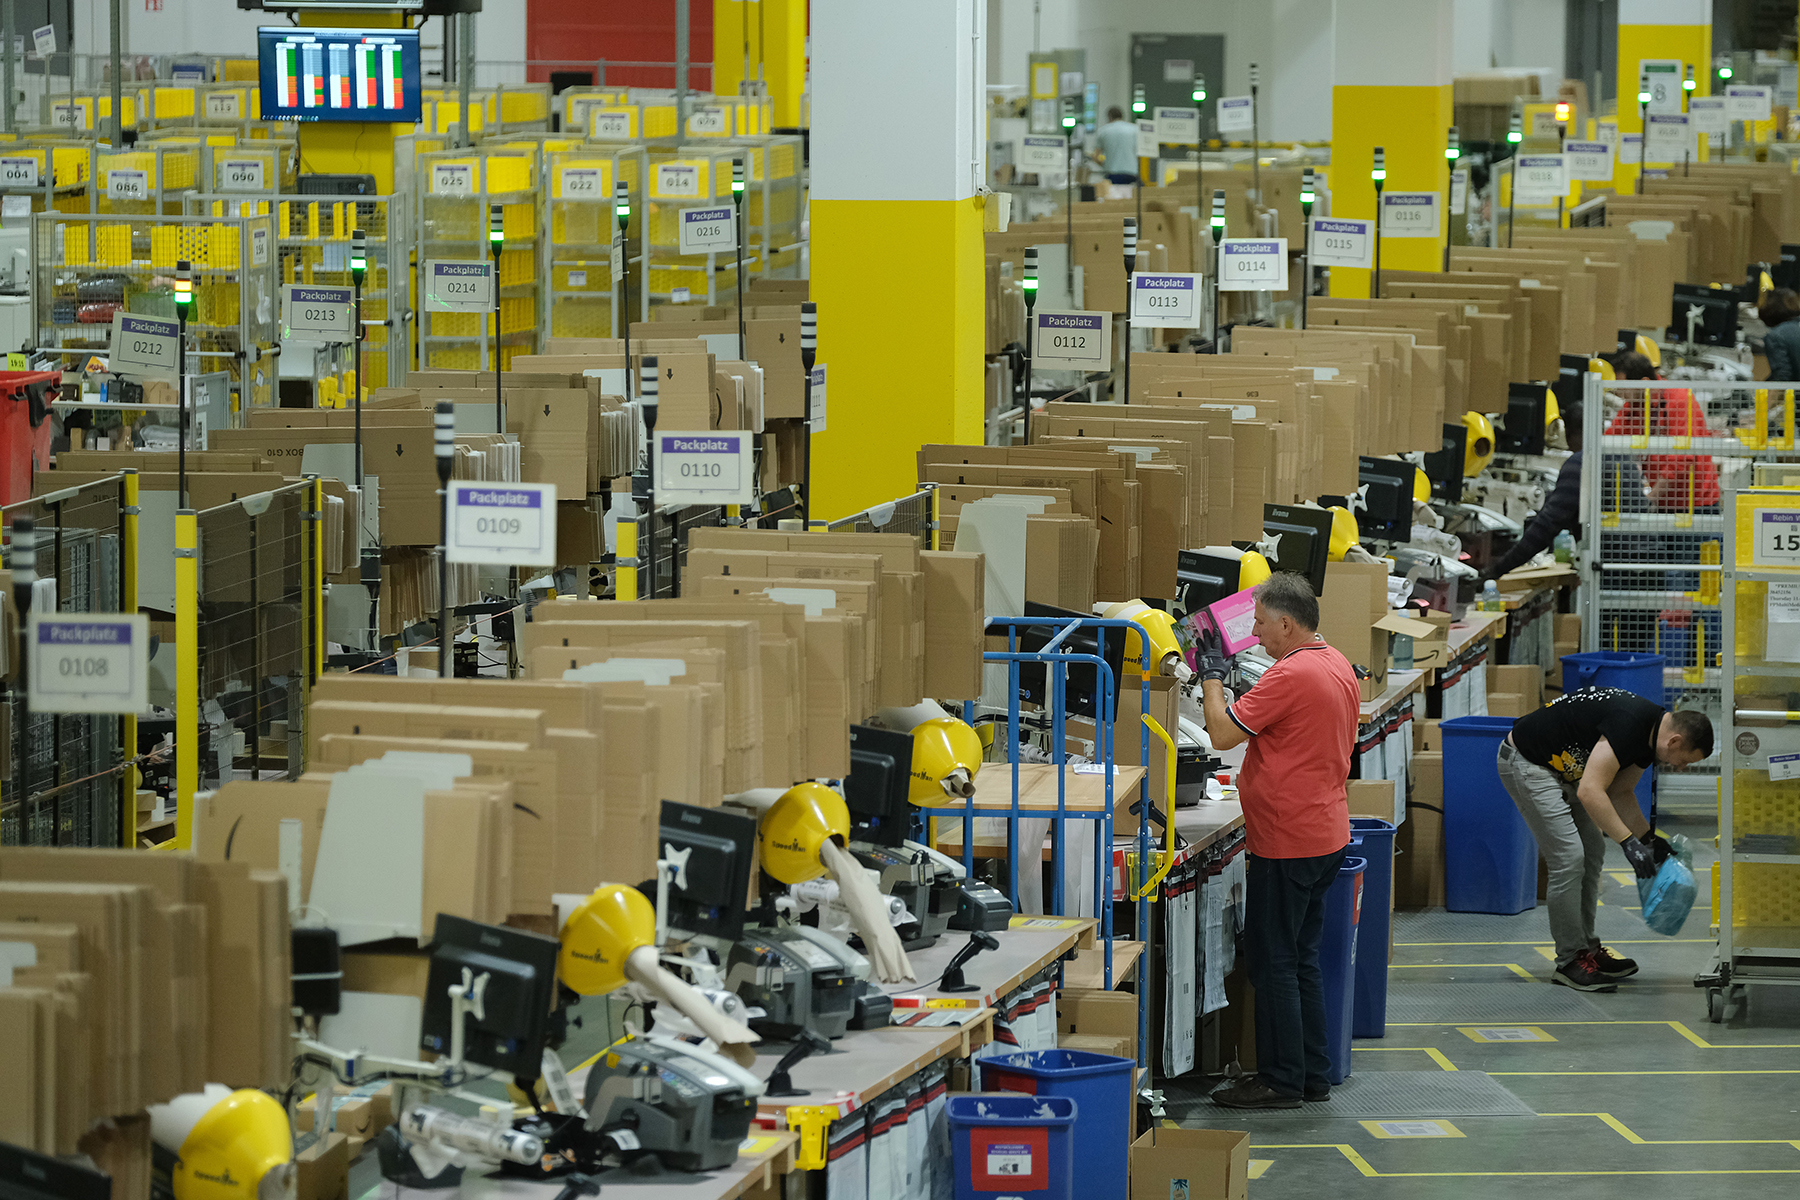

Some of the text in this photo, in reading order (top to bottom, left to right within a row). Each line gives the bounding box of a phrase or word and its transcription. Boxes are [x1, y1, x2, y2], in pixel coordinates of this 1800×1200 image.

[6, 170, 28, 179] 004
[232, 172, 255, 182] 090
[441, 176, 463, 186] 025
[570, 180, 593, 190] 022
[692, 211, 724, 221] Packplatz
[1395, 211, 1422, 221] 0116
[696, 226, 721, 237] 0216
[1321, 222, 1359, 233] Packplatz
[1233, 244, 1271, 254] Packplatz
[1325, 238, 1353, 249] 0115
[443, 265, 481, 275] Packplatz
[1238, 261, 1266, 272] 0114
[447, 282, 476, 294] 0214
[1145, 278, 1185, 288] Packplatz
[300, 291, 342, 302] Packplatz
[1149, 296, 1178, 308] 0113
[305, 309, 336, 321] 0213
[130, 321, 170, 334] Packplatz
[1048, 316, 1092, 328] Packplatz
[133, 340, 162, 355] 0212
[1053, 335, 1086, 349] 0112
[673, 439, 729, 452] Packplatz
[267, 448, 304, 457] BOX G10
[680, 462, 721, 477] 0110
[469, 490, 530, 506] Packplatz
[476, 517, 521, 534] 0109
[50, 625, 118, 643] Packplatz
[58, 657, 109, 677] 0108
